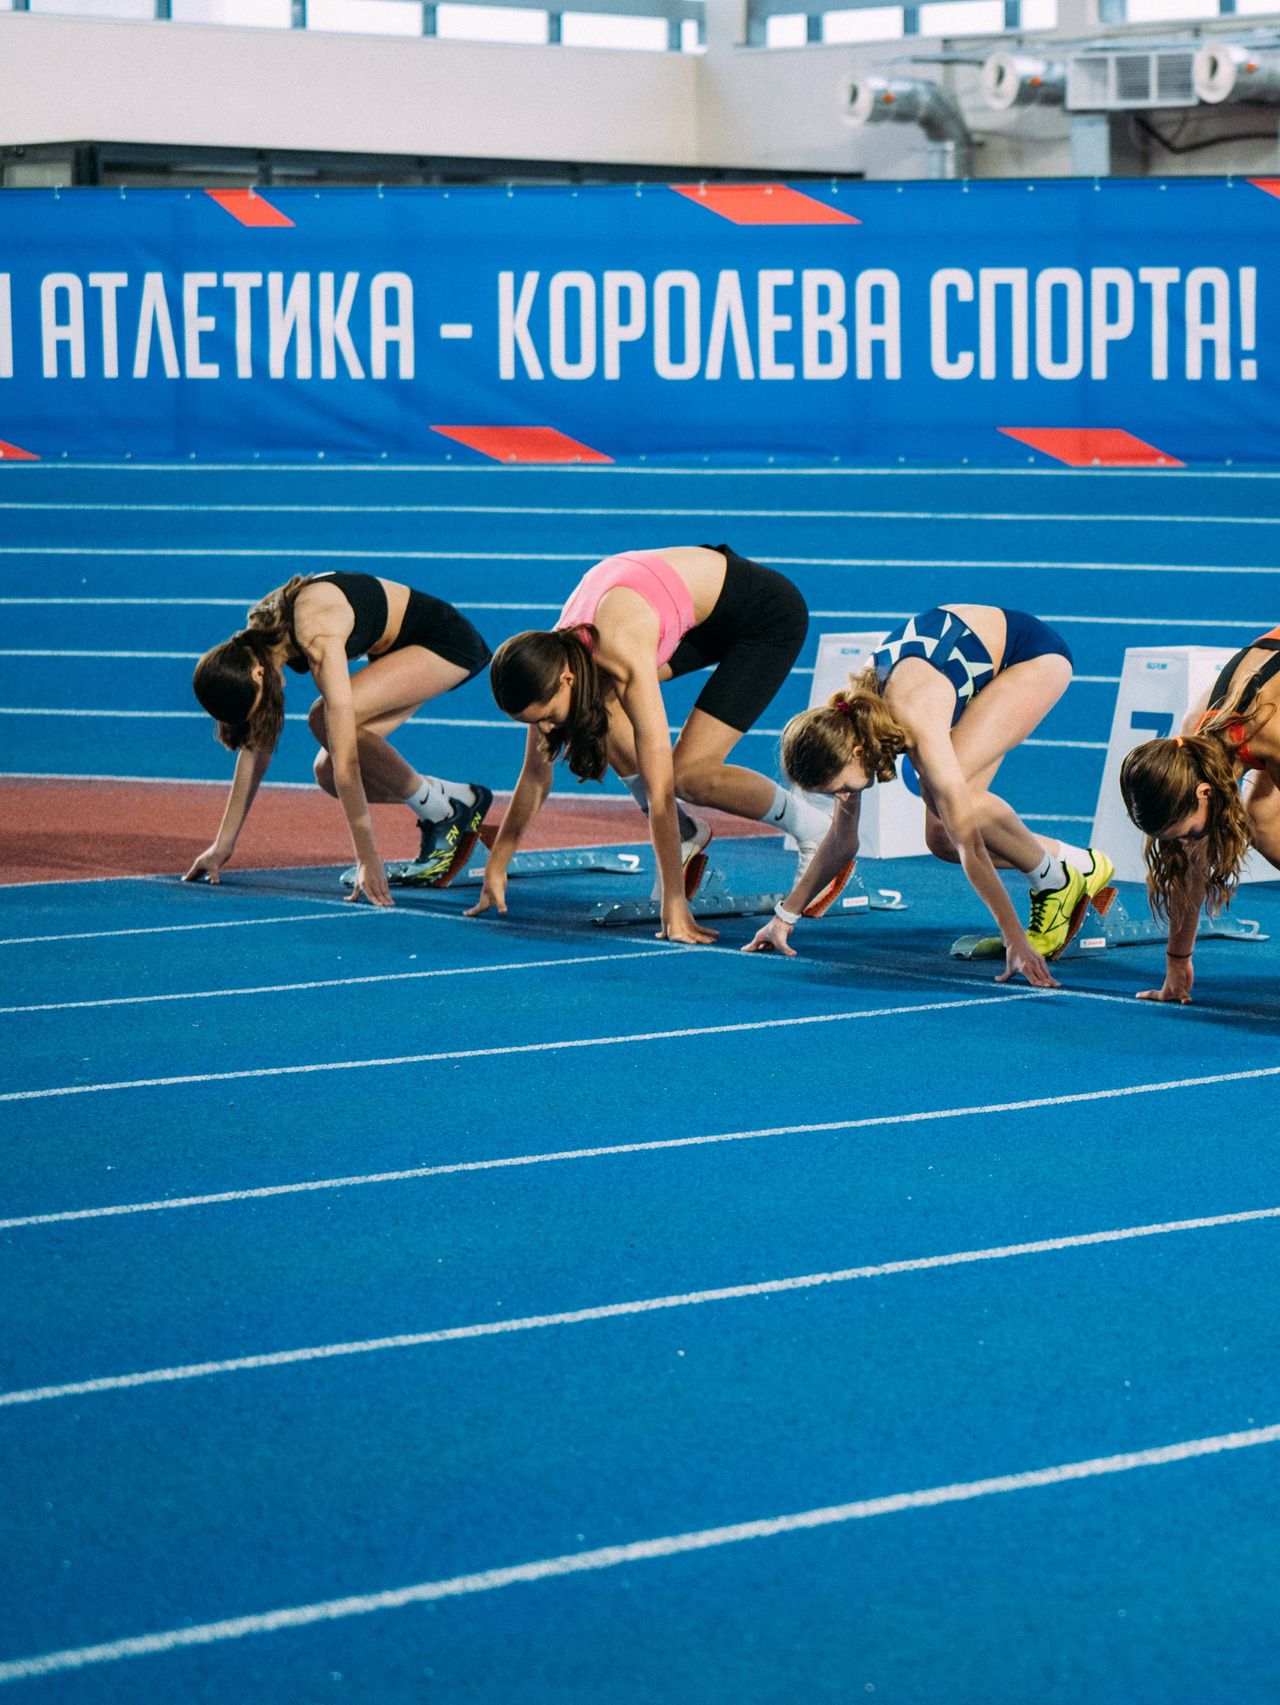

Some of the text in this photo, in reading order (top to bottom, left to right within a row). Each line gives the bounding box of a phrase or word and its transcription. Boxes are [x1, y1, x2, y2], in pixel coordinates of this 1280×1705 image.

[41, 272, 415, 379] АТЛЕТИКА
[499, 270, 901, 380] КОРОЛЕВА
[930, 267, 1257, 380] СПОРТА!
